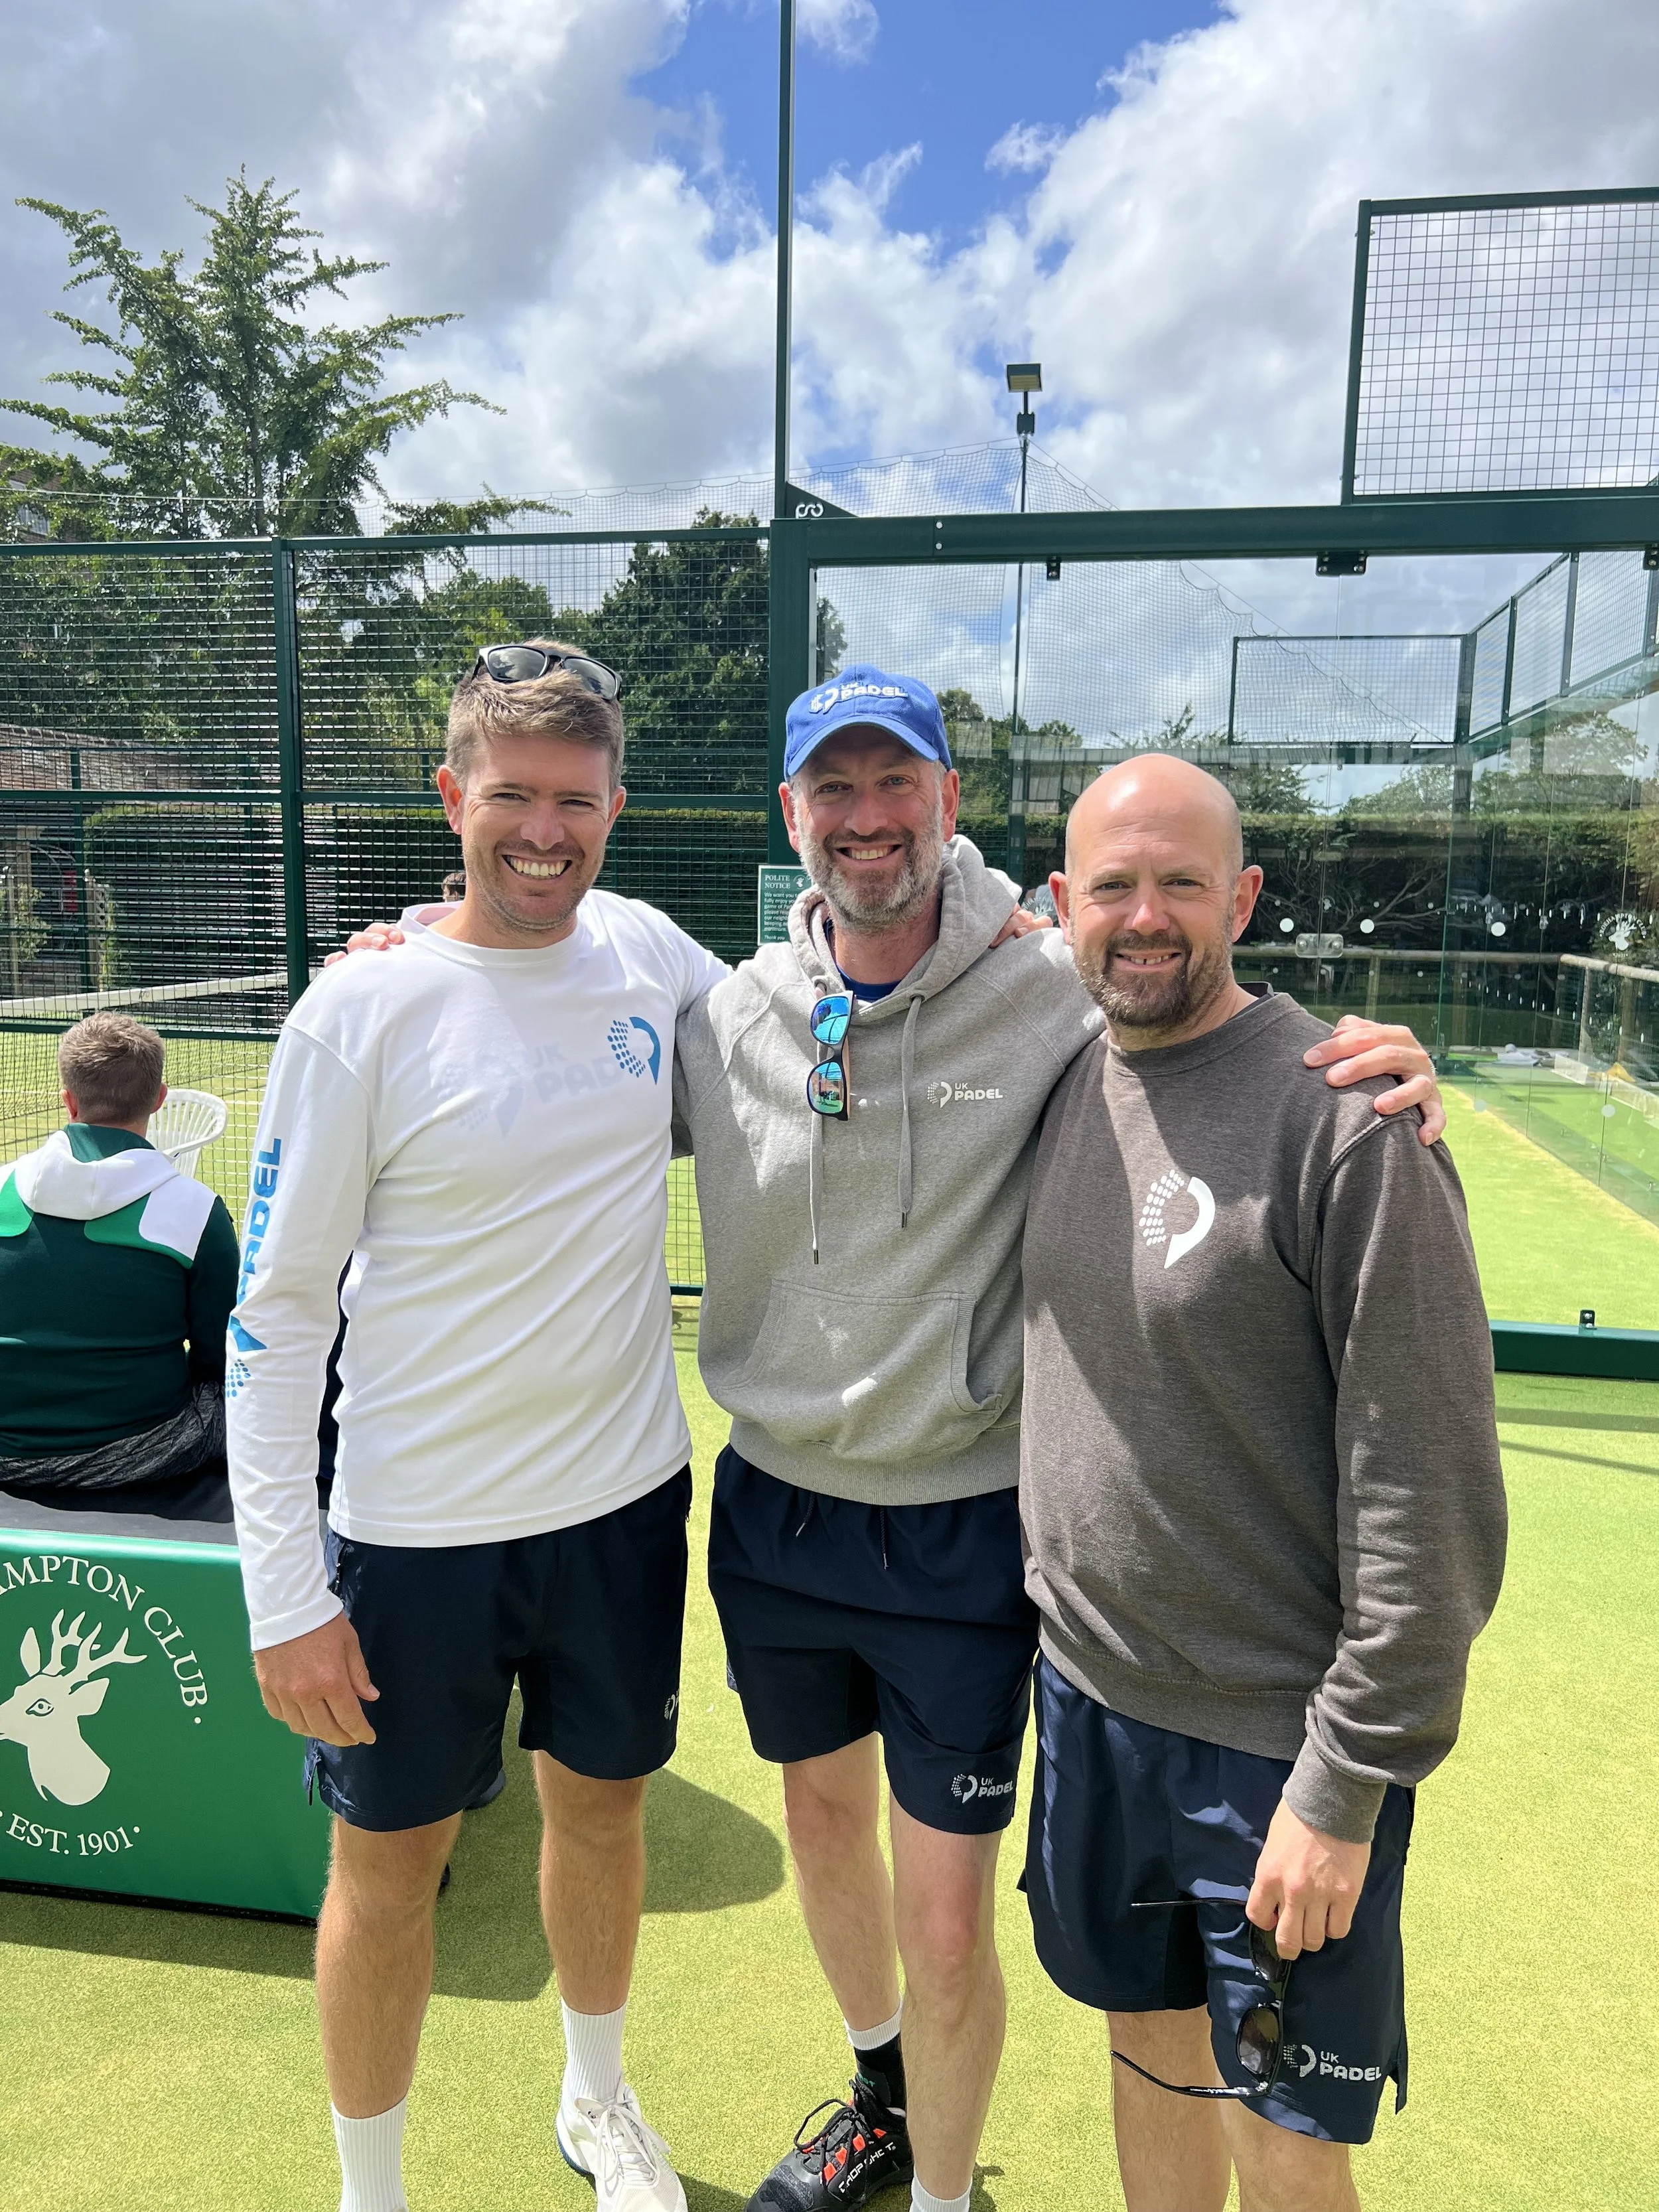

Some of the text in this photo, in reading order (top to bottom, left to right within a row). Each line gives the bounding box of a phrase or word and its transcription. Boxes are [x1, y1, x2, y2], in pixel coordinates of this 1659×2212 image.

[841, 684, 907, 701] PADEL
[954, 1088, 1003, 1101] PADEL
[237, 1138, 281, 1305] PADEL
[0, 1555, 208, 1707] MPTON CLUB
[977, 1780, 1014, 1797] PADEL
[981, 1777, 994, 1786] UK
[5, 1813, 133, 1856] EST. 1901
[1320, 2051, 1339, 2063] UK
[1319, 2061, 1382, 2081] PADEL
